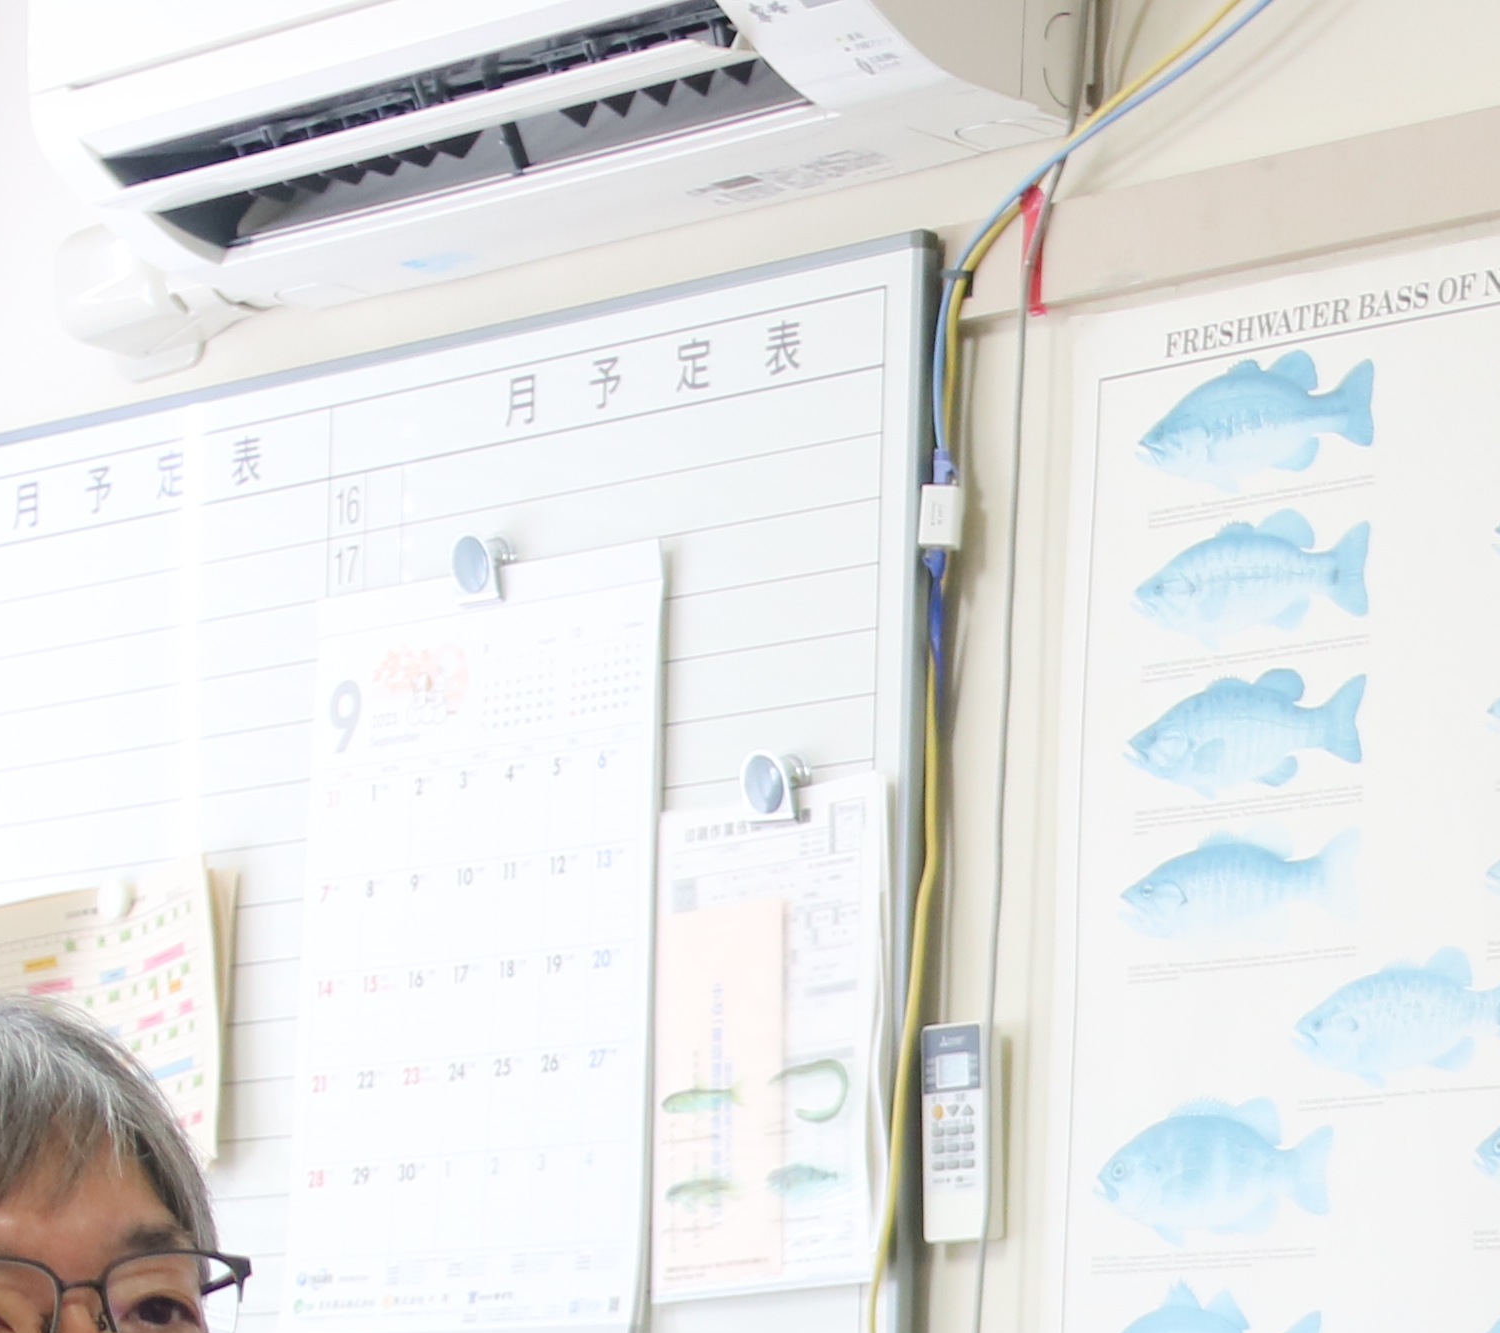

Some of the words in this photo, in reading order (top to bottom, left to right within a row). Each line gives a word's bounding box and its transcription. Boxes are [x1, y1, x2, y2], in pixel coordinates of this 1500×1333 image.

[1163, 296, 1352, 360] FRESHWATER
[1357, 281, 1431, 318] BASS
[1437, 269, 1477, 306] OF
[504, 319, 803, 430] 月予定表
[329, 678, 362, 755] 9
